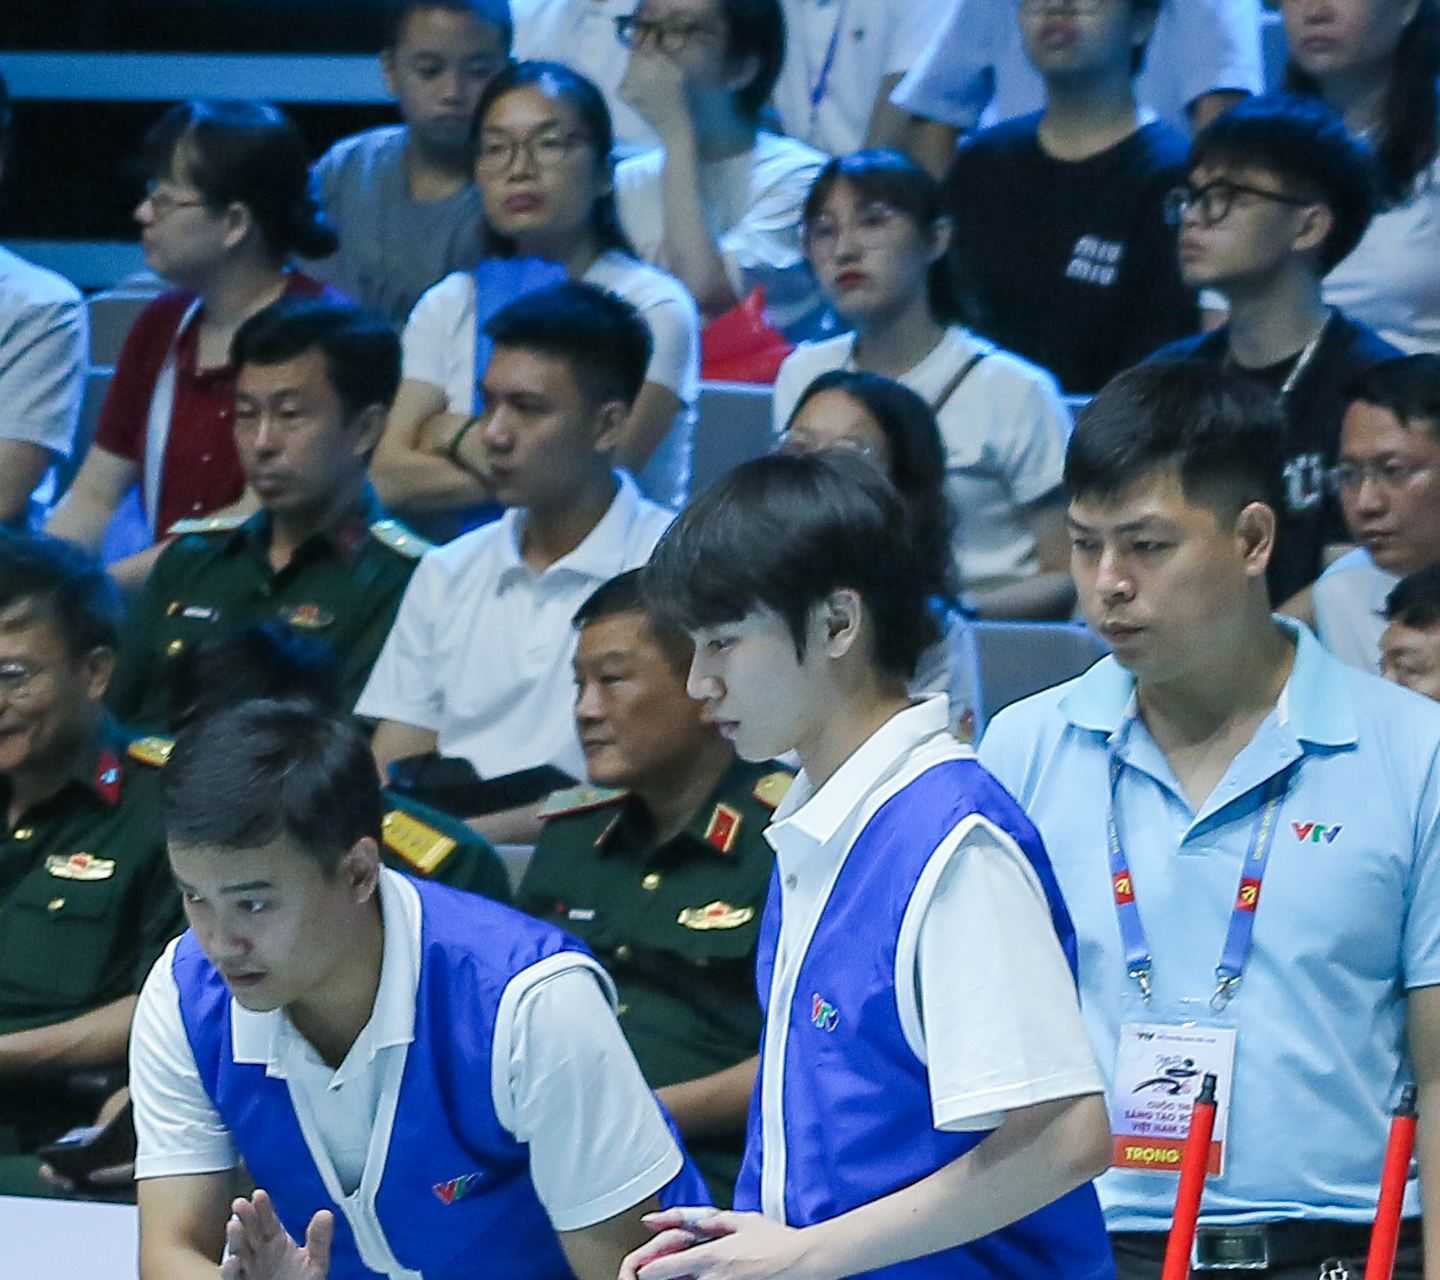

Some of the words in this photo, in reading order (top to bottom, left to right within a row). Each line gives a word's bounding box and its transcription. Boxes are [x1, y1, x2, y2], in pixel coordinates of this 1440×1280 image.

[1290, 821, 1343, 846] VTV
[811, 991, 840, 1033] VTV
[1124, 1146, 1179, 1165] TRỌNG
[432, 1172, 484, 1206] VTV
